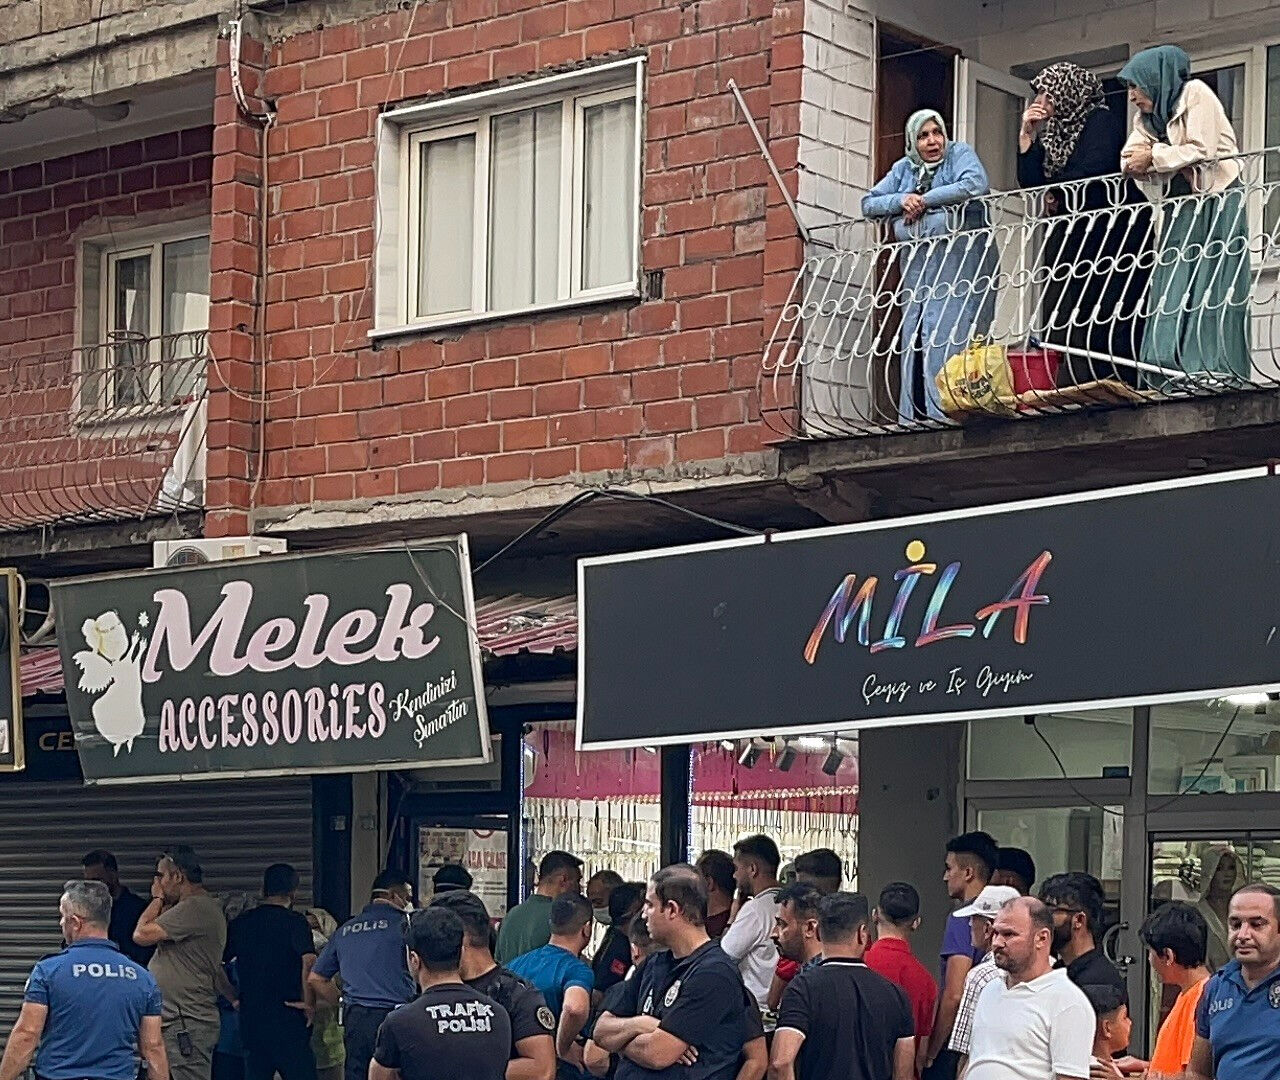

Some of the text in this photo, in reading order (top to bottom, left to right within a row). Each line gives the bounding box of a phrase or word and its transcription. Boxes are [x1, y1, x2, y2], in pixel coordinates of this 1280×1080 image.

[141, 580, 440, 683] Melek
[803, 540, 1053, 664] MİLA
[388, 669, 457, 722] Kendinizi
[72, 963, 138, 981] POLİS
